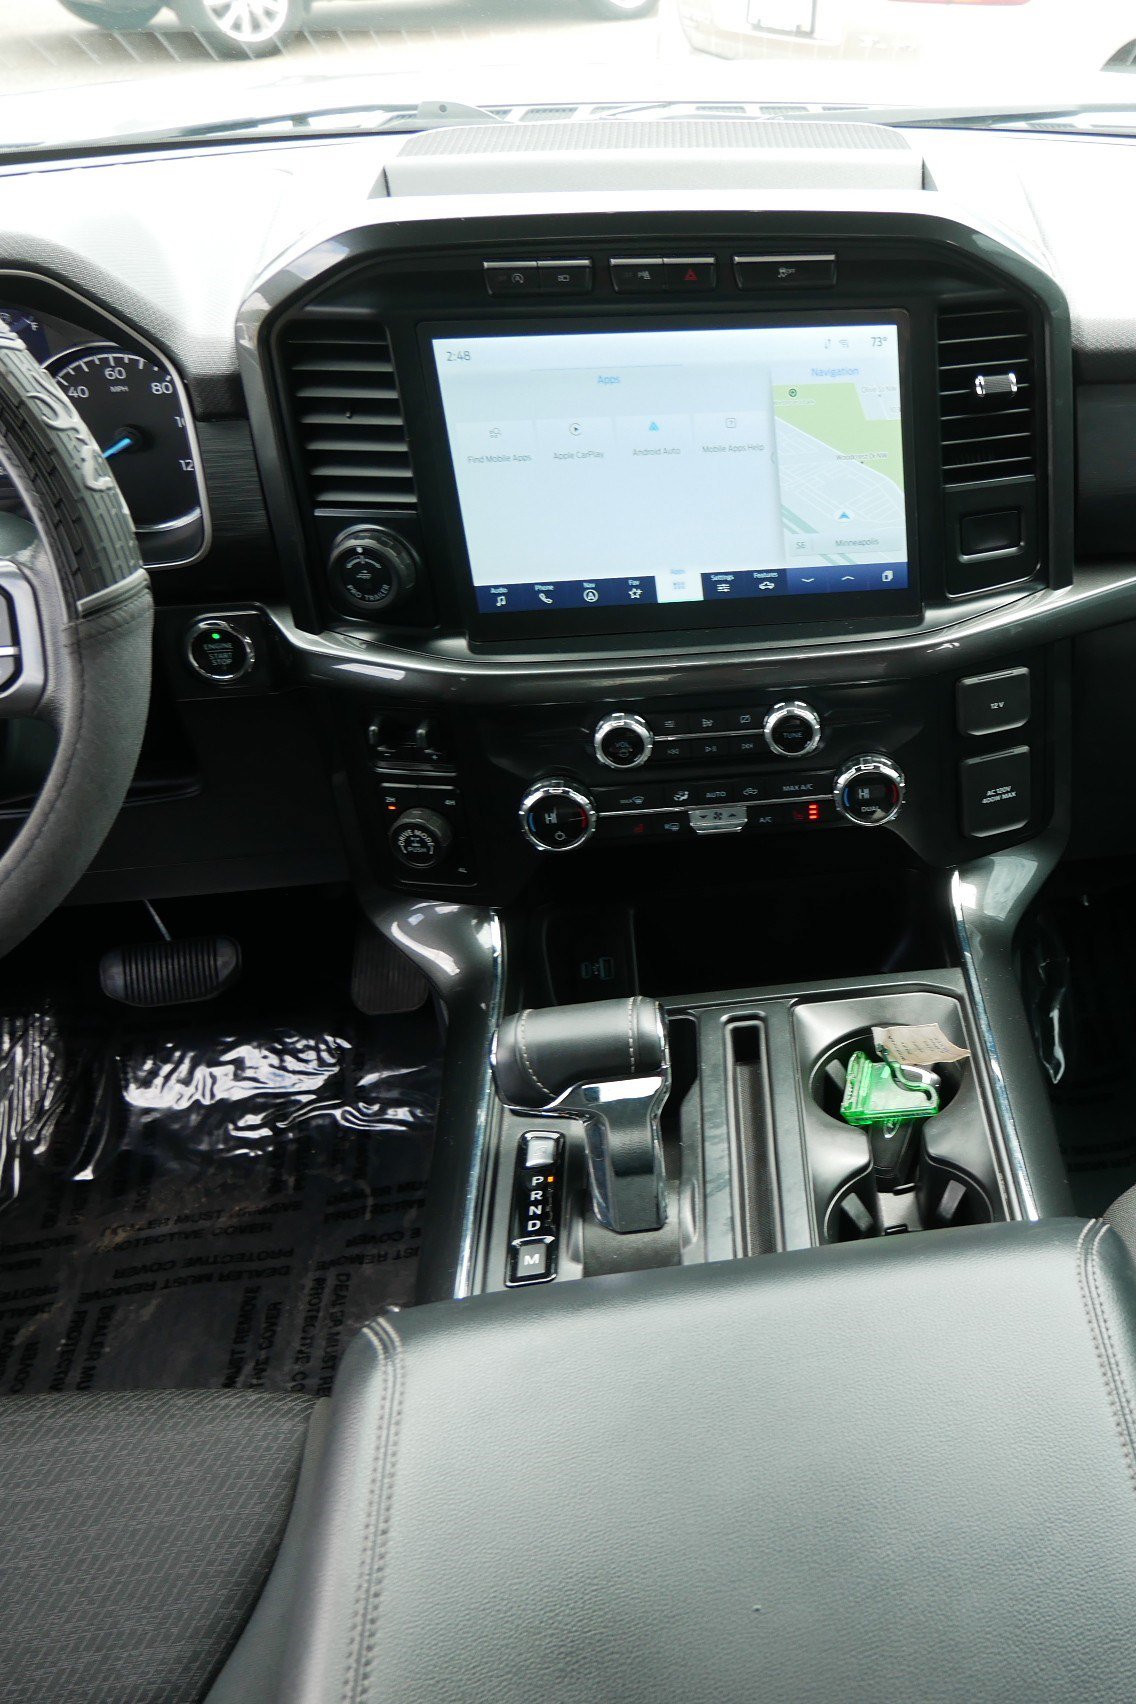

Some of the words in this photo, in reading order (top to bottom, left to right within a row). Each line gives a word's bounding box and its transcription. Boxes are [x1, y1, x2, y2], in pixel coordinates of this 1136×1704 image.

[446, 350, 471, 361] 2:48
[104, 367, 126, 380] 60
[811, 367, 859, 379] Navigation
[598, 375, 621, 385] Apps
[68, 385, 89, 399] 40
[109, 385, 129, 393] MPH
[151, 382, 174, 394] 80
[632, 447, 662, 456] Android
[663, 446, 681, 454] Auto
[702, 445, 727, 453] Mobile
[728, 444, 747, 454] Apps
[748, 443, 764, 453] Help
[467, 455, 485, 464] Find
[486, 453, 511, 463] Mobile
[512, 453, 532, 464] Apps
[553, 451, 574, 461] Apple
[576, 450, 604, 460] CarPlay
[796, 541, 805, 549] SE
[835, 537, 879, 548] Minneapolis
[710, 574, 735, 582] Settings
[753, 571, 779, 579] Features
[490, 586, 508, 594] Audio
[534, 584, 554, 592] Phone
[583, 581, 596, 589] Nav
[347, 584, 363, 598] PRO
[363, 584, 391, 600] TRAILER
[203, 643, 233, 651] ENGINE
[208, 652, 233, 660] START
[859, 788, 870, 799] HI
[1002, 792, 1017, 800] MAX
[397, 829, 413, 846] DRIVE
[414, 829, 435, 846] MODE
[532, 1177, 544, 1186] P
[530, 1190, 543, 1200] R
[529, 1205, 542, 1216] N
[212, 1222, 273, 1237] COVER
[527, 1220, 541, 1231] D
[182, 1248, 294, 1269] PROTECTIVE
[523, 1254, 540, 1265] M
[112, 1260, 177, 1280] COVER
[219, 1265, 291, 1282] DEALER
[160, 1272, 214, 1290] MUST
[78, 1281, 157, 1303] REMOVE
